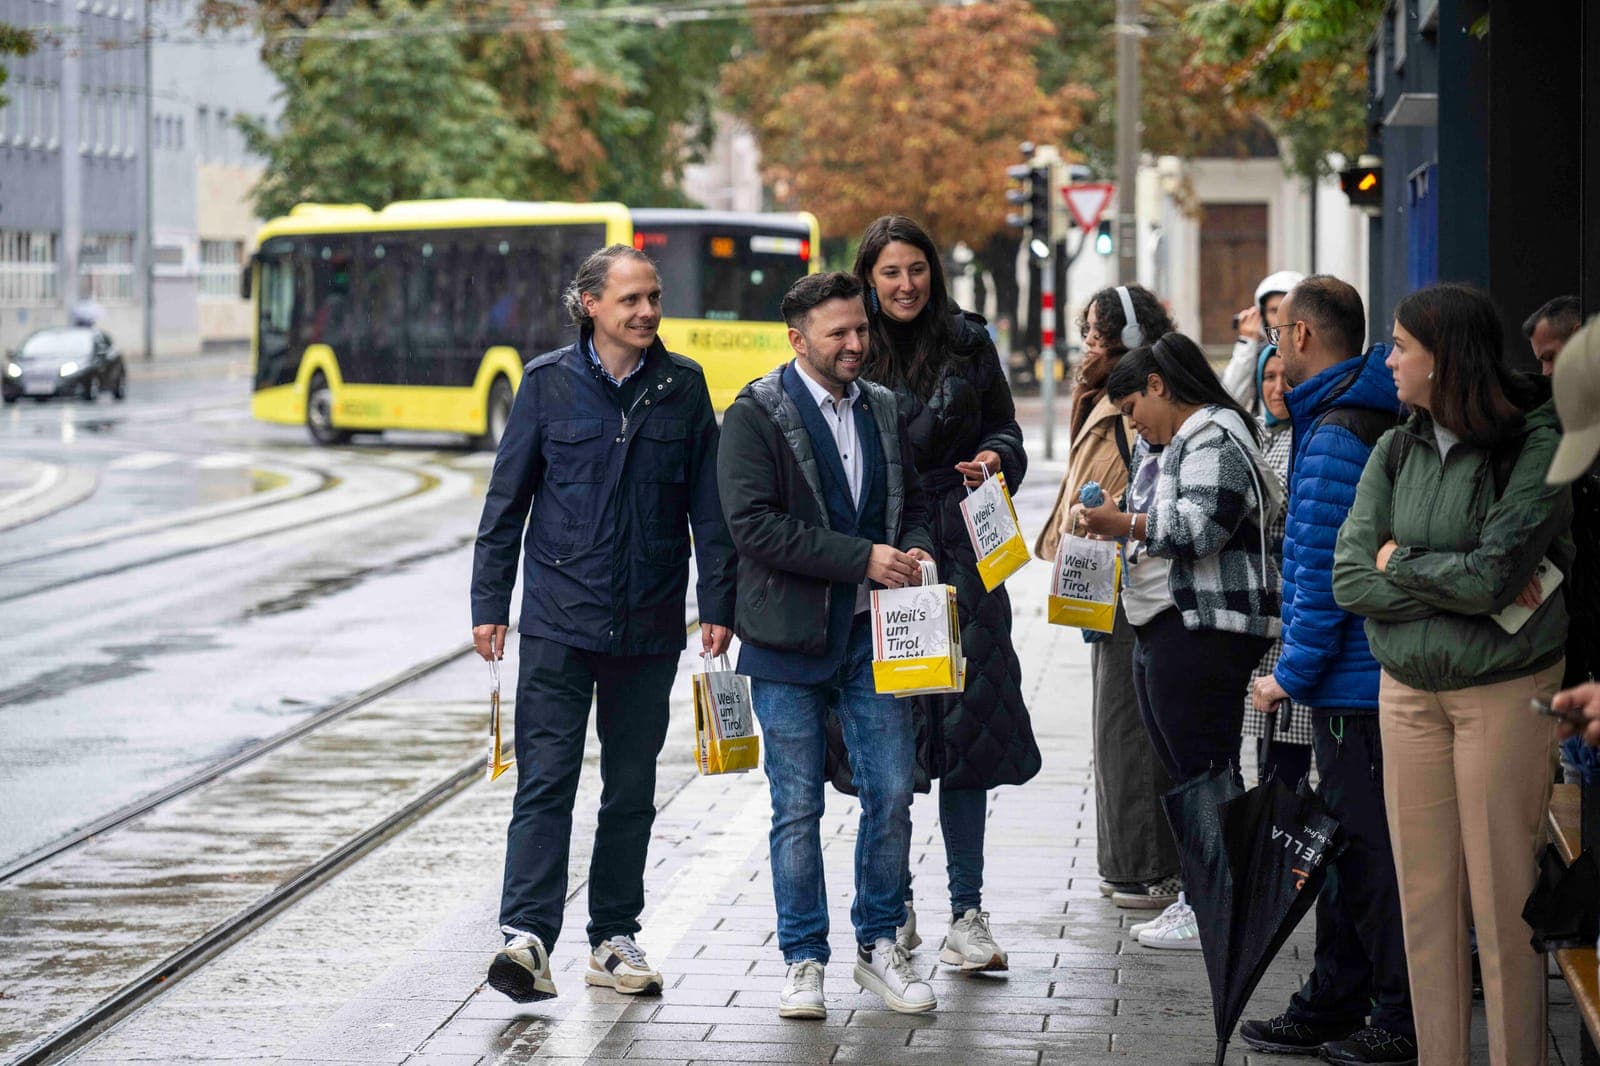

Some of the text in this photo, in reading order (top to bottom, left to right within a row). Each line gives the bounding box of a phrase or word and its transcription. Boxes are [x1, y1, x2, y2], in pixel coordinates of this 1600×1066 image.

[973, 502, 996, 526] Weil's
[976, 521, 990, 537] um
[979, 528, 999, 550] Tirol
[1064, 554, 1098, 571] Weil's
[1062, 568, 1082, 579] um
[1062, 578, 1090, 593] Tirol
[886, 608, 926, 624] Weil's
[886, 625, 909, 637] um
[887, 637, 919, 651] Tirol
[720, 707, 734, 717] um
[722, 717, 742, 731] Tirol
